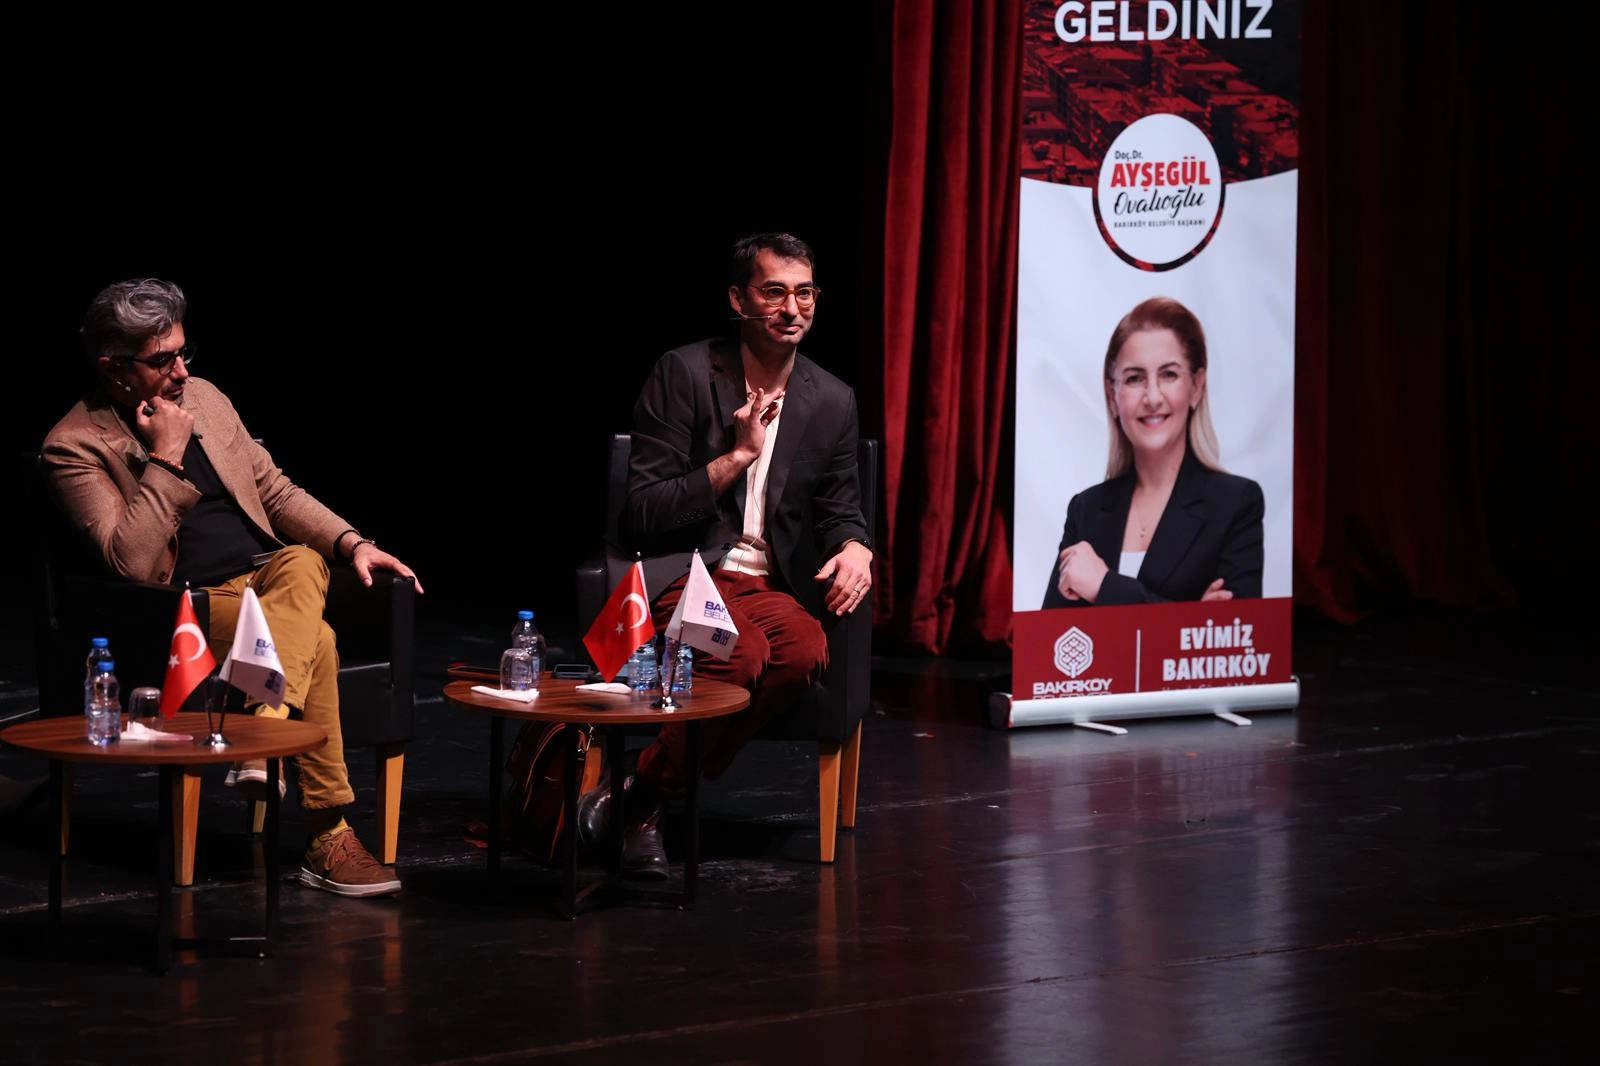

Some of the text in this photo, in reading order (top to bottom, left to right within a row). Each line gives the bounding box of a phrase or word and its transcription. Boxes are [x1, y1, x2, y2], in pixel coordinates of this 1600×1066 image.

[1110, 156, 1211, 192] AYŞEGÜL
[1113, 185, 1205, 219] Ovalıoğlu
[1180, 617, 1253, 651] EVİMİZ
[1163, 647, 1271, 681] BAKIRKÖY
